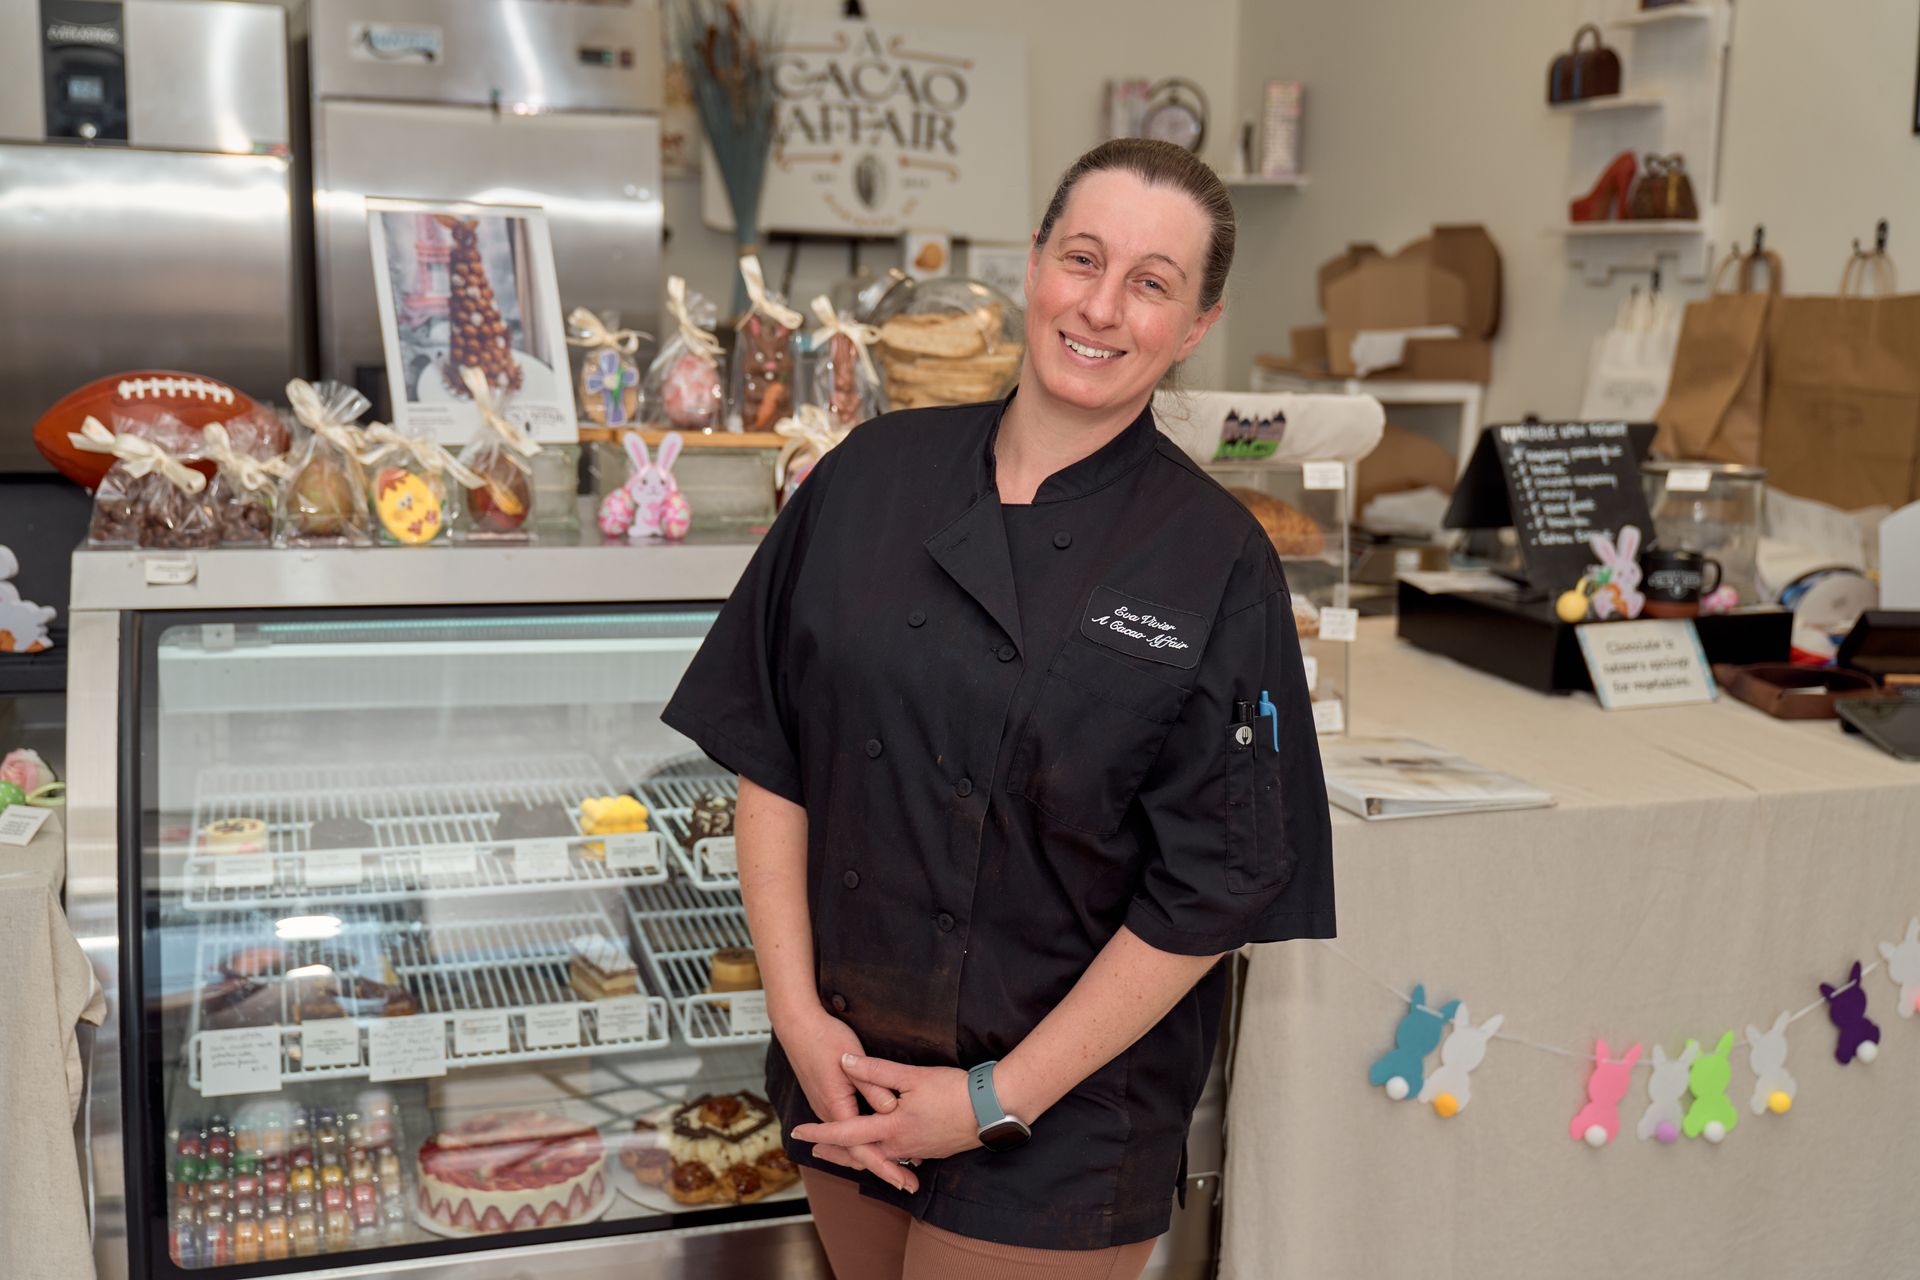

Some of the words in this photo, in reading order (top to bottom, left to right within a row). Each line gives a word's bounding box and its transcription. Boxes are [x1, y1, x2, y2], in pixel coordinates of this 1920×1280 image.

[852, 28, 883, 58] A
[772, 56, 968, 112] CACAO
[785, 102, 958, 154] AFFAIR
[1091, 615, 1111, 625] A
[1109, 620, 1146, 640] Cacao
[1145, 633, 1189, 649] Affair
[1114, 606, 1140, 622] Eva
[1140, 614, 1177, 631] Vivier
